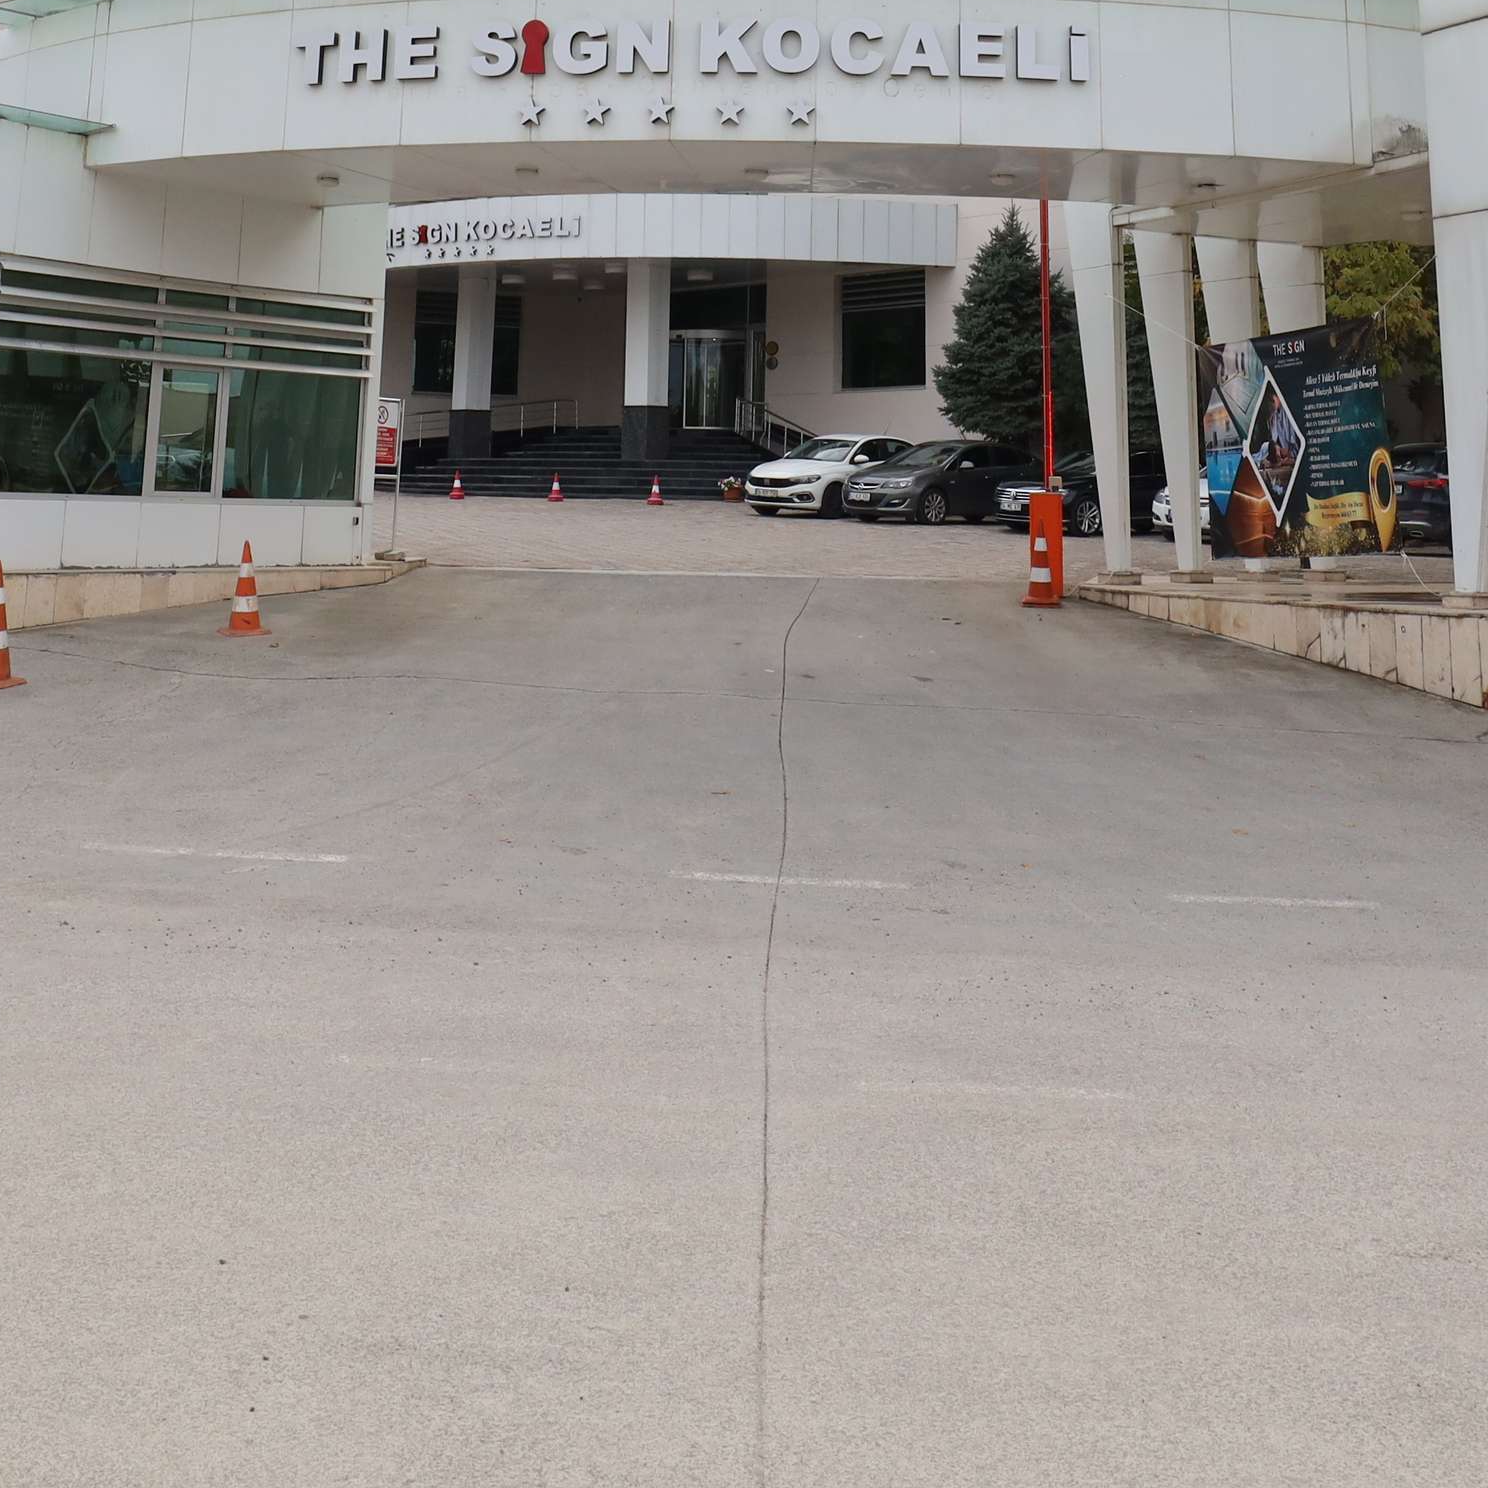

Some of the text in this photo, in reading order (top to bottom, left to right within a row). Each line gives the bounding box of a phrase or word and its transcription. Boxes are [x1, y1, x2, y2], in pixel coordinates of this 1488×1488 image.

[295, 25, 440, 86] THE
[470, 18, 672, 79] SIGN
[1272, 342, 1286, 357] THE
